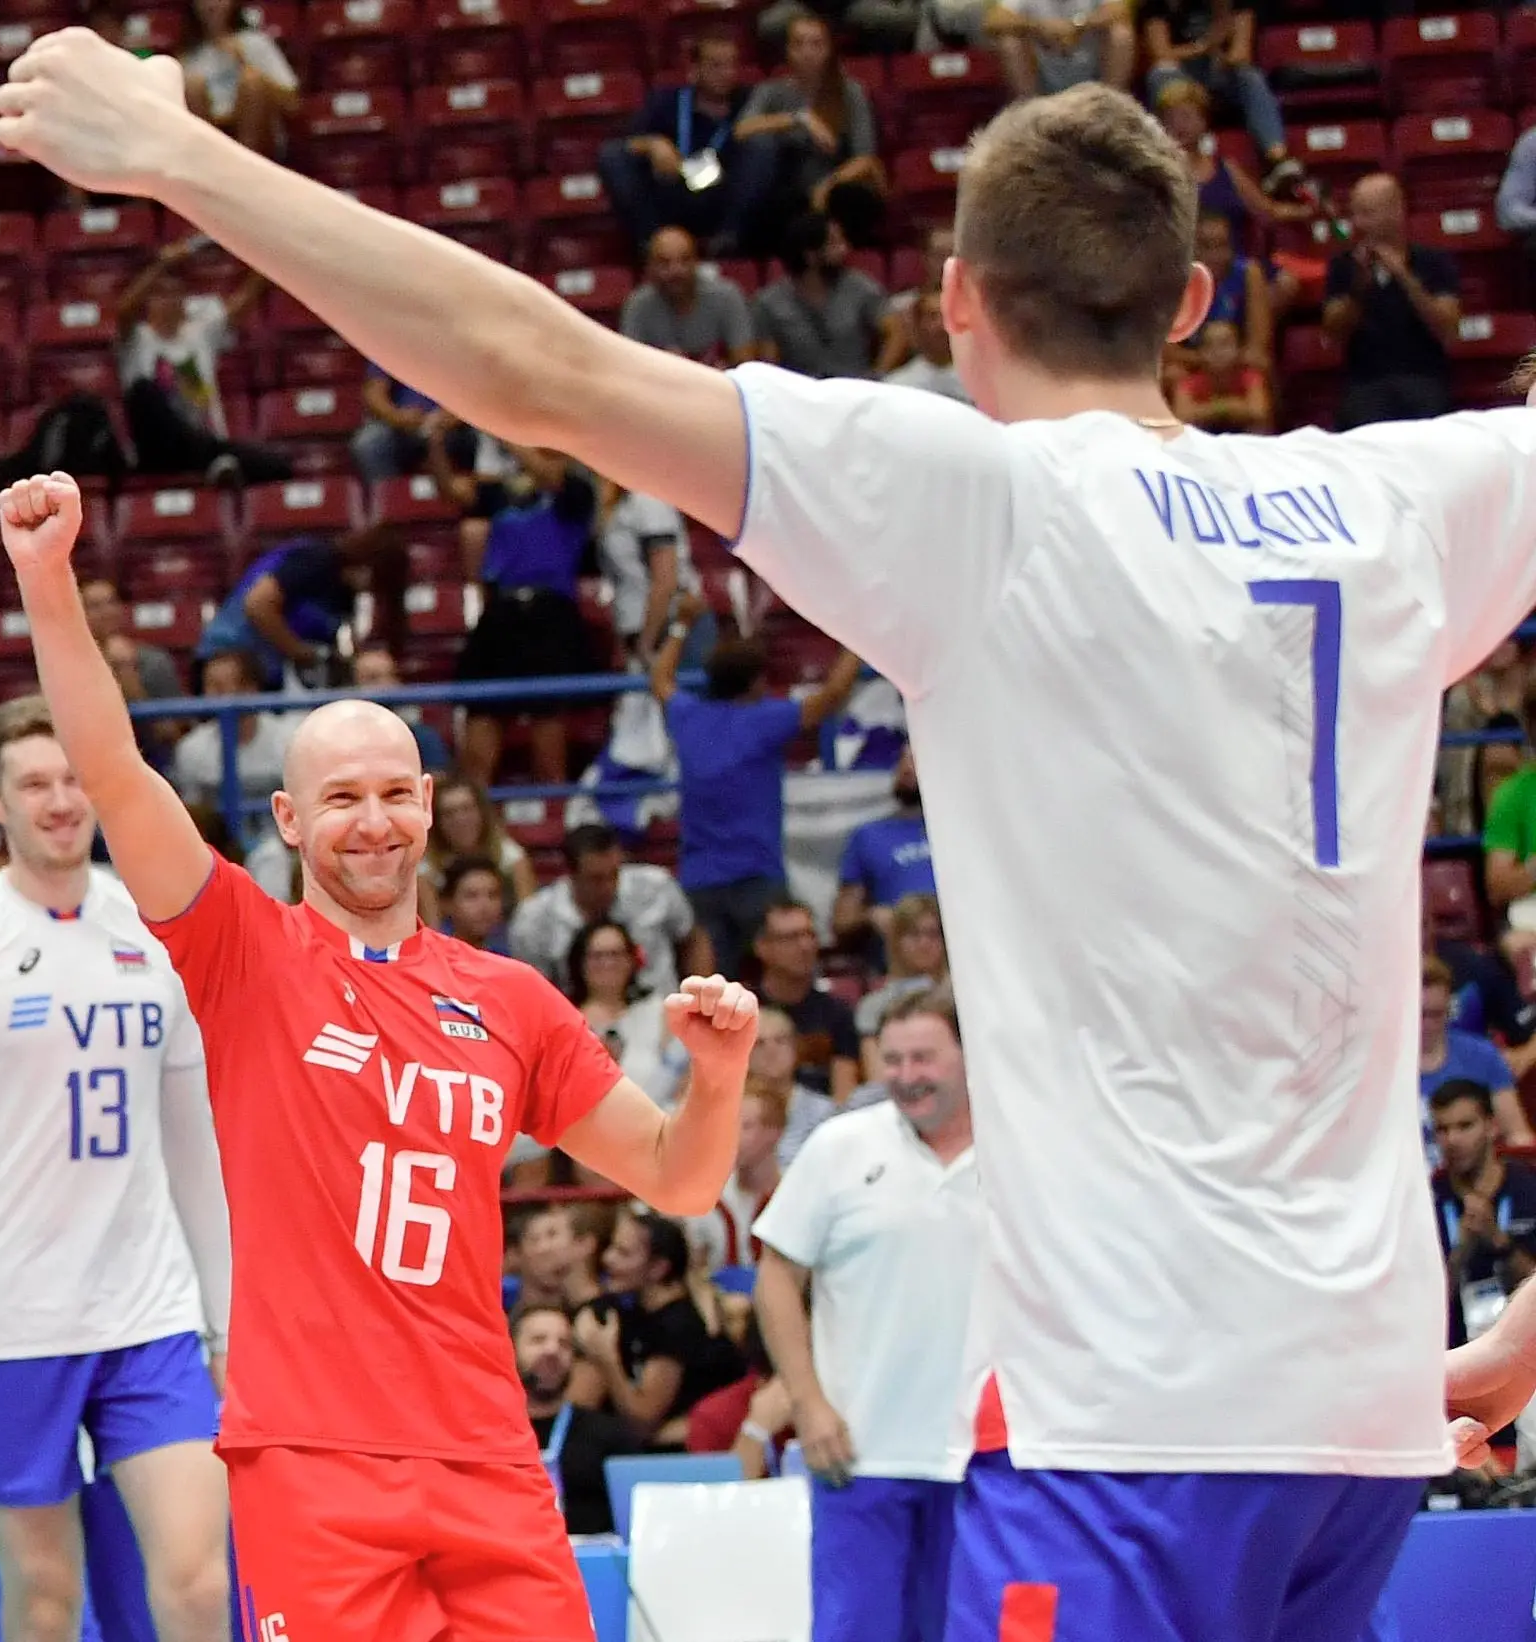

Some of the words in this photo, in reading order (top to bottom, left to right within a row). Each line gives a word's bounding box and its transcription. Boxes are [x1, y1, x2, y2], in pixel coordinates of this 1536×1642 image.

[1245, 579, 1342, 867] 7
[63, 1002, 163, 1049] VTB
[448, 1023, 482, 1039] RUS
[67, 1068, 129, 1160] 13
[380, 1053, 505, 1146] VTB
[354, 1141, 457, 1286] 16
